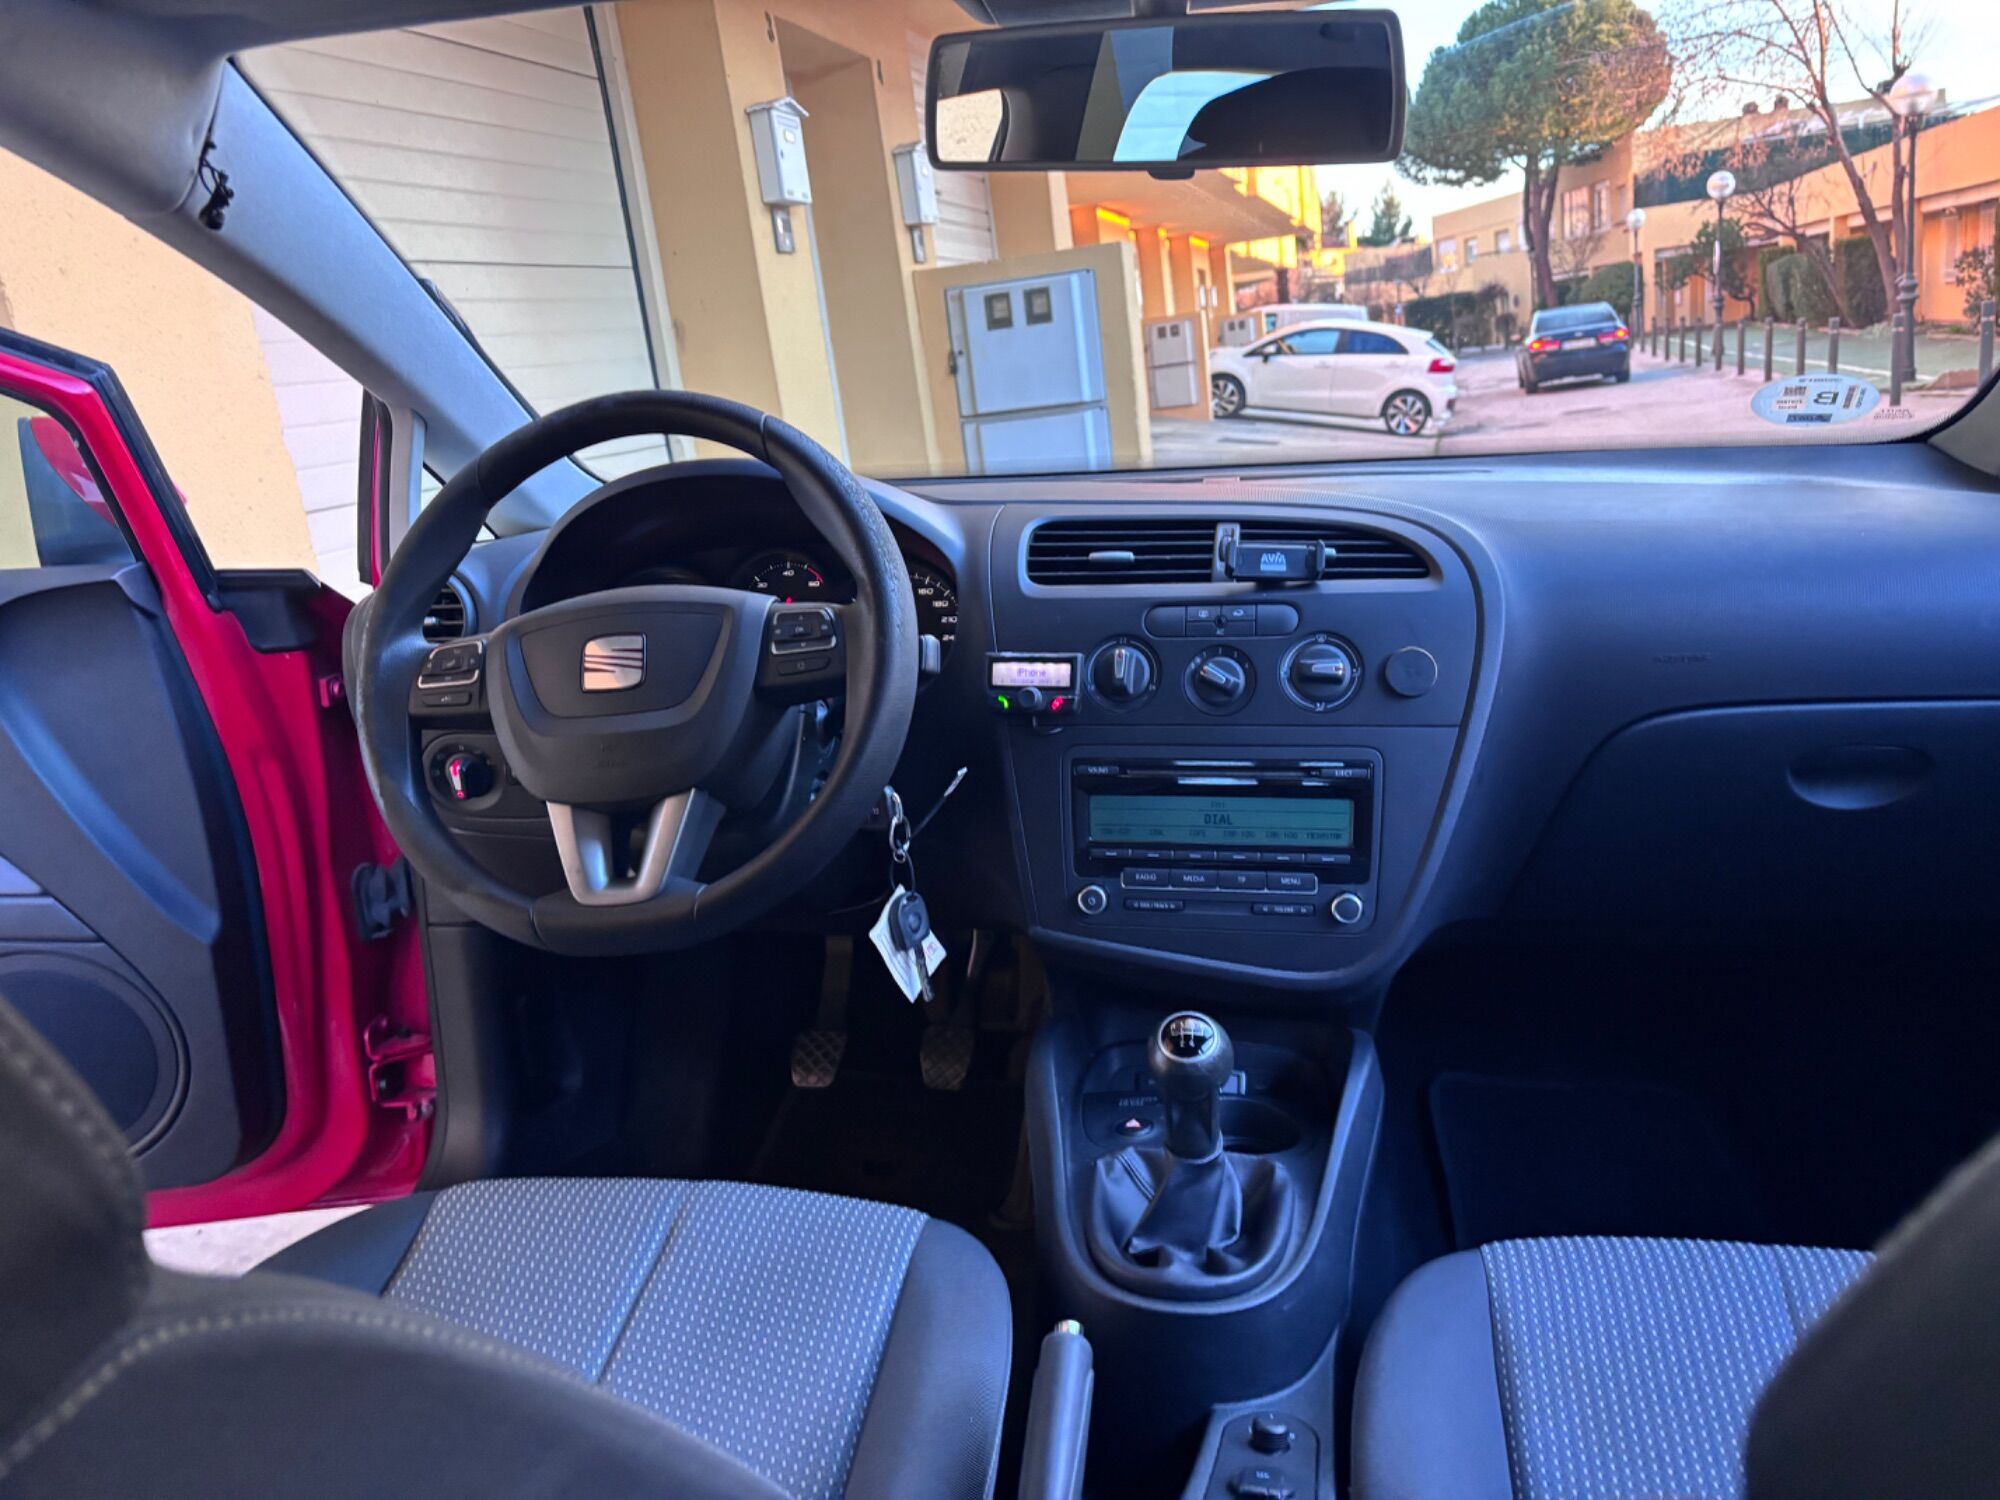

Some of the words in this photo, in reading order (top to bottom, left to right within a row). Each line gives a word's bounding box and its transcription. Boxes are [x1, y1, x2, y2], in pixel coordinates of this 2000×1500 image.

[1017, 668, 1046, 678] iPhone
[1204, 813, 1233, 825] DIAL
[1135, 872, 1157, 880] RADIO
